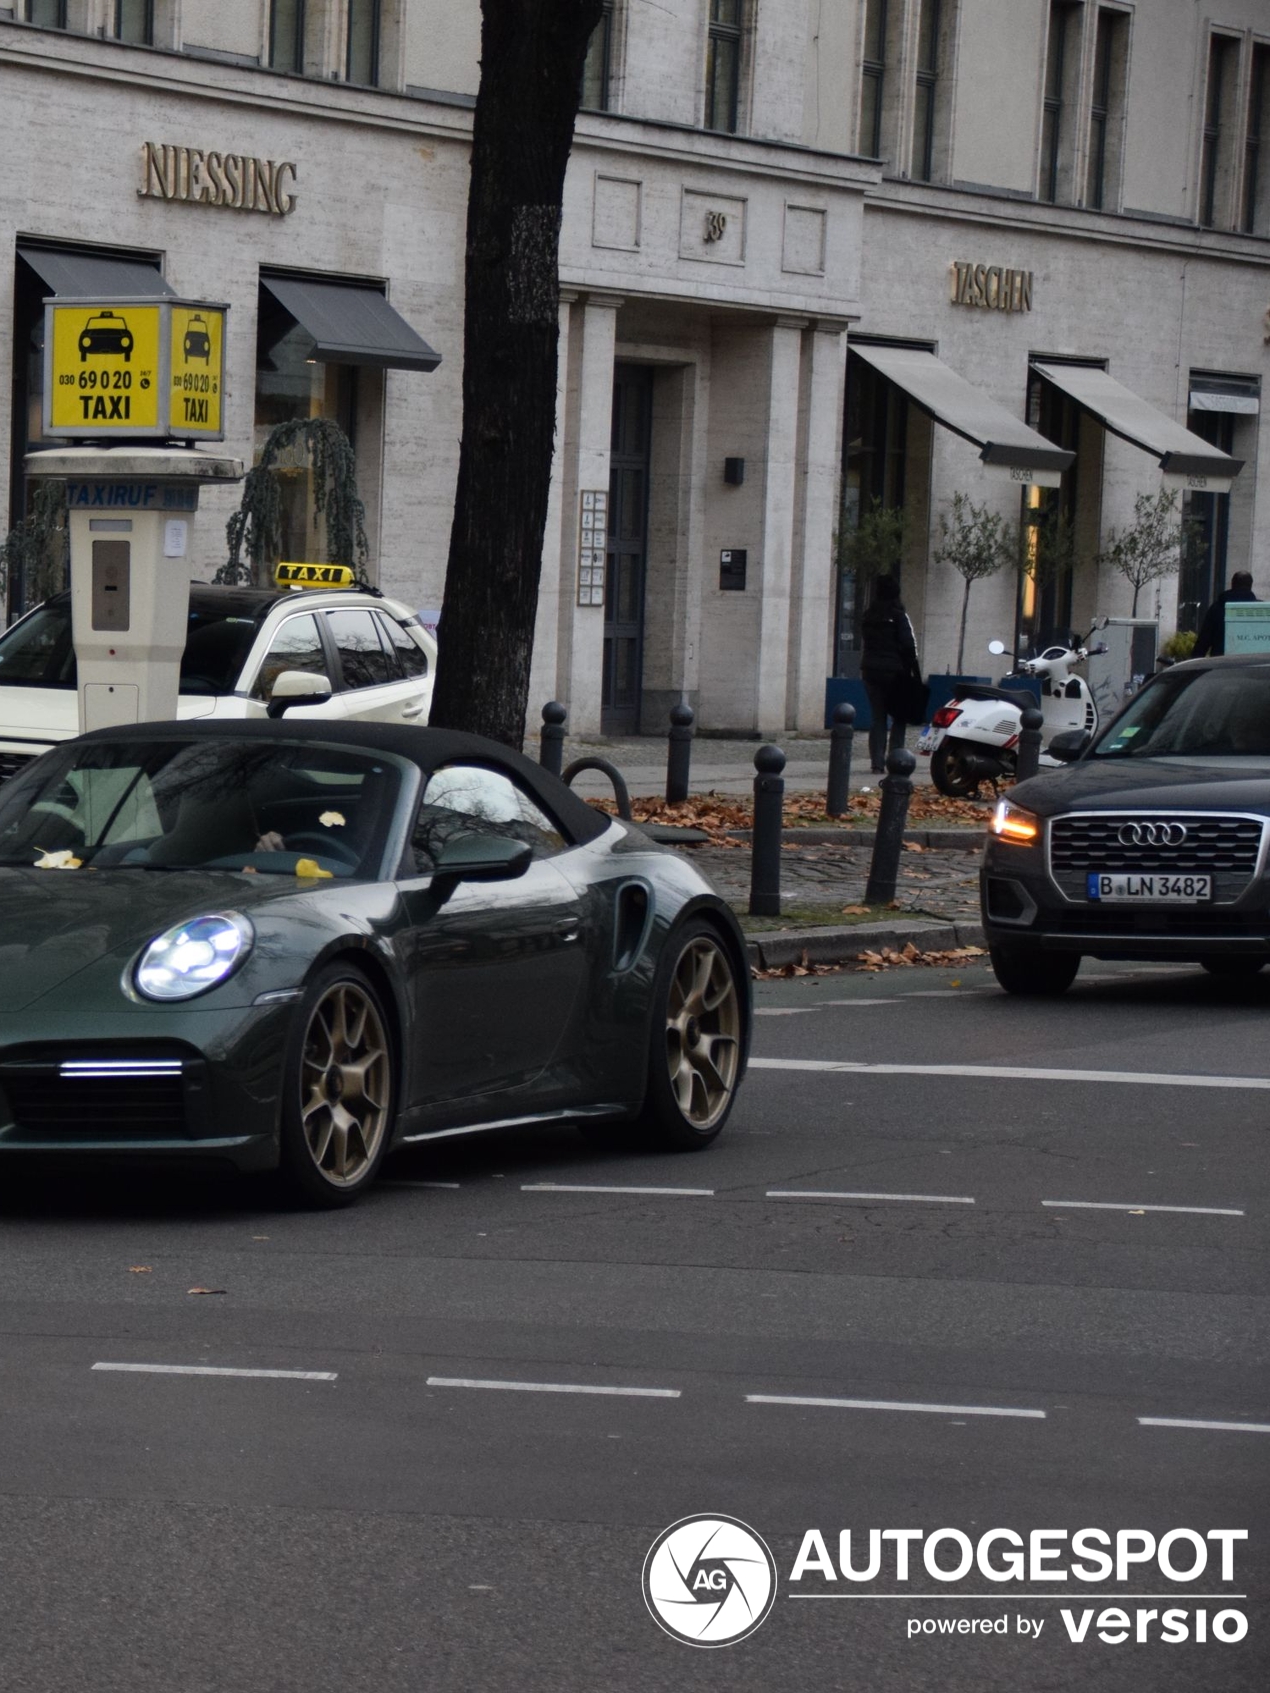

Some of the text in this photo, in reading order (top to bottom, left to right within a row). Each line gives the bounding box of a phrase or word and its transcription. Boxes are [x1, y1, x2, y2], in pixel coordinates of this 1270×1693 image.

[137, 141, 299, 215] NIESSING
[952, 261, 1034, 312] TASCHEN
[59, 374, 75, 386] 030
[79, 395, 131, 420] TAXI
[183, 397, 209, 423] TAXI
[67, 483, 158, 507] TAXIRUF
[287, 566, 335, 582] TAXI
[1100, 876, 1114, 896] B
[1127, 877, 1154, 897] LN
[1158, 877, 1209, 898] 3482
